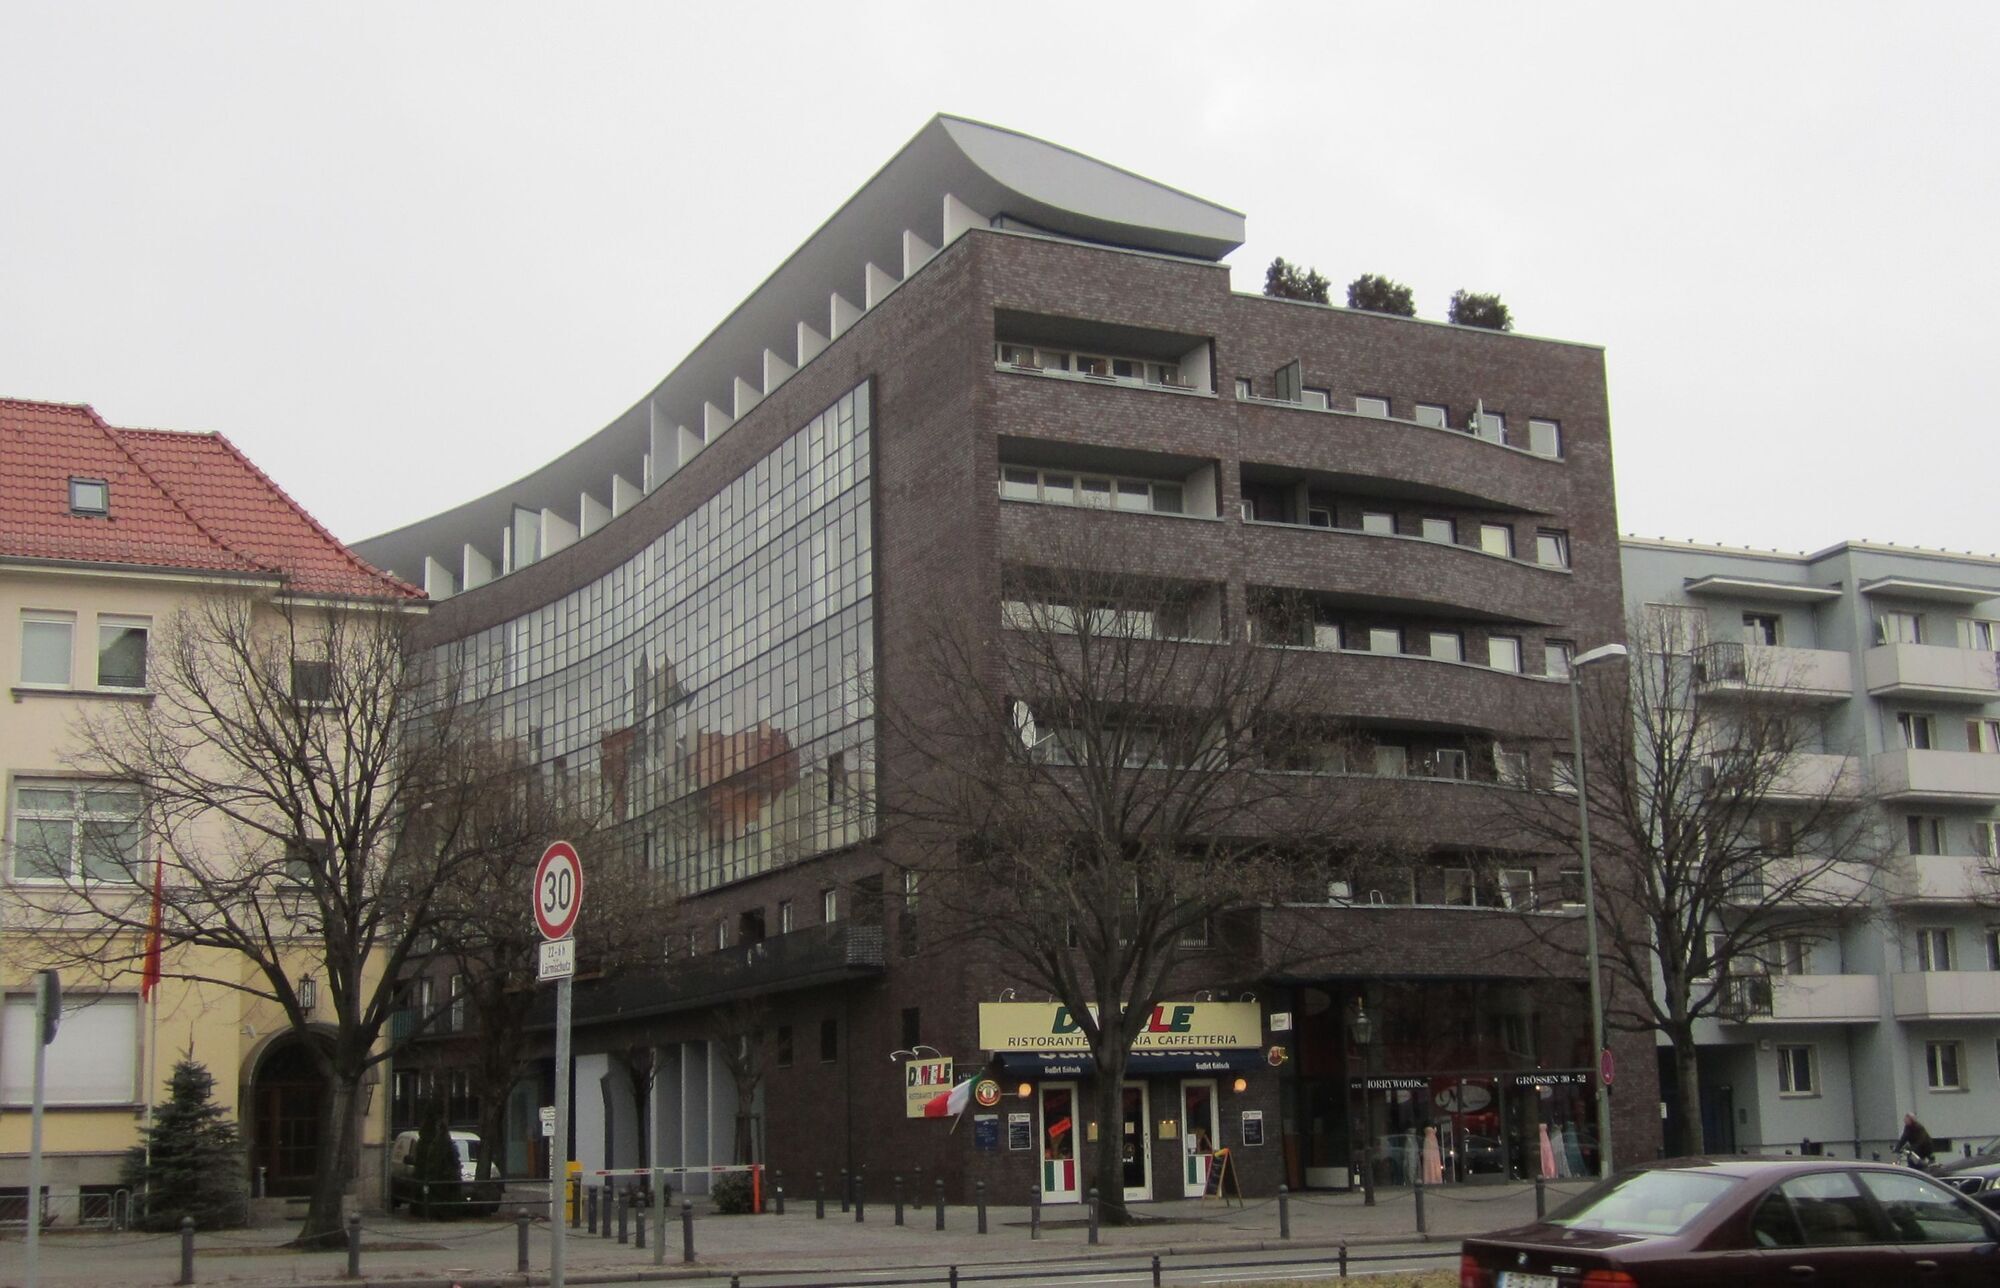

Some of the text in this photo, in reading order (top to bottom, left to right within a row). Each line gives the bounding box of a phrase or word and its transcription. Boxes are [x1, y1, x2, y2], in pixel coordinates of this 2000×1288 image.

[544, 868, 571, 912] 30
[1008, 1036, 1089, 1046] RISTORANTE
[1158, 1035, 1238, 1045] CAFFETTERIA
[908, 1063, 951, 1087] DANIELE
[1515, 1075, 1559, 1085] GRÖSSEN
